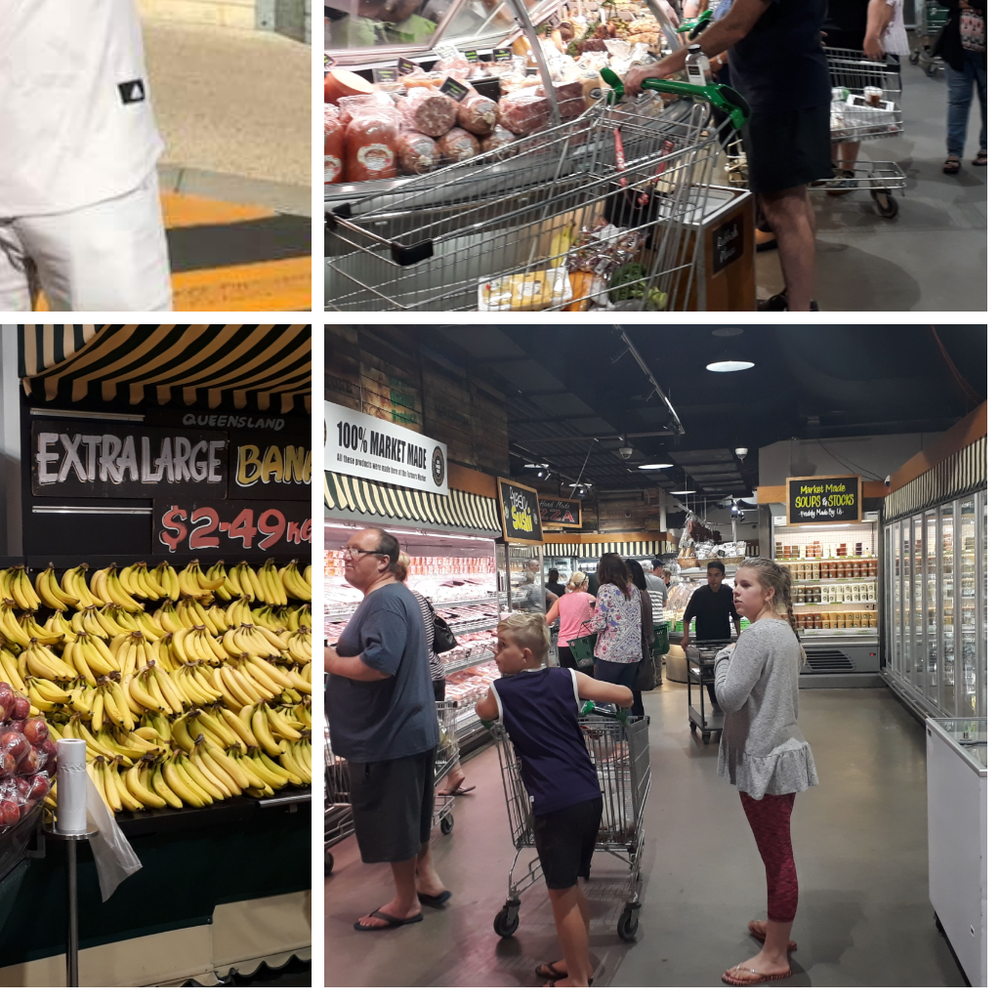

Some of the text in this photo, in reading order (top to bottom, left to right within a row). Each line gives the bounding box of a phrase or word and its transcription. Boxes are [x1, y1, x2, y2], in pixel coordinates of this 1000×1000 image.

[182, 413, 285, 431] QUEENSLAND
[336, 421, 368, 454] 100%
[369, 430, 406, 464] MARKET
[407, 442, 427, 470] MADE
[35, 432, 139, 485] EXTRA
[141, 436, 226, 484] LARGE
[800, 483, 847, 494] Market Made
[540, 499, 571, 509] Hand Made
[795, 495, 822, 508] SOUPS
[828, 494, 855, 507] STOCKS
[540, 508, 575, 523] ZZA
